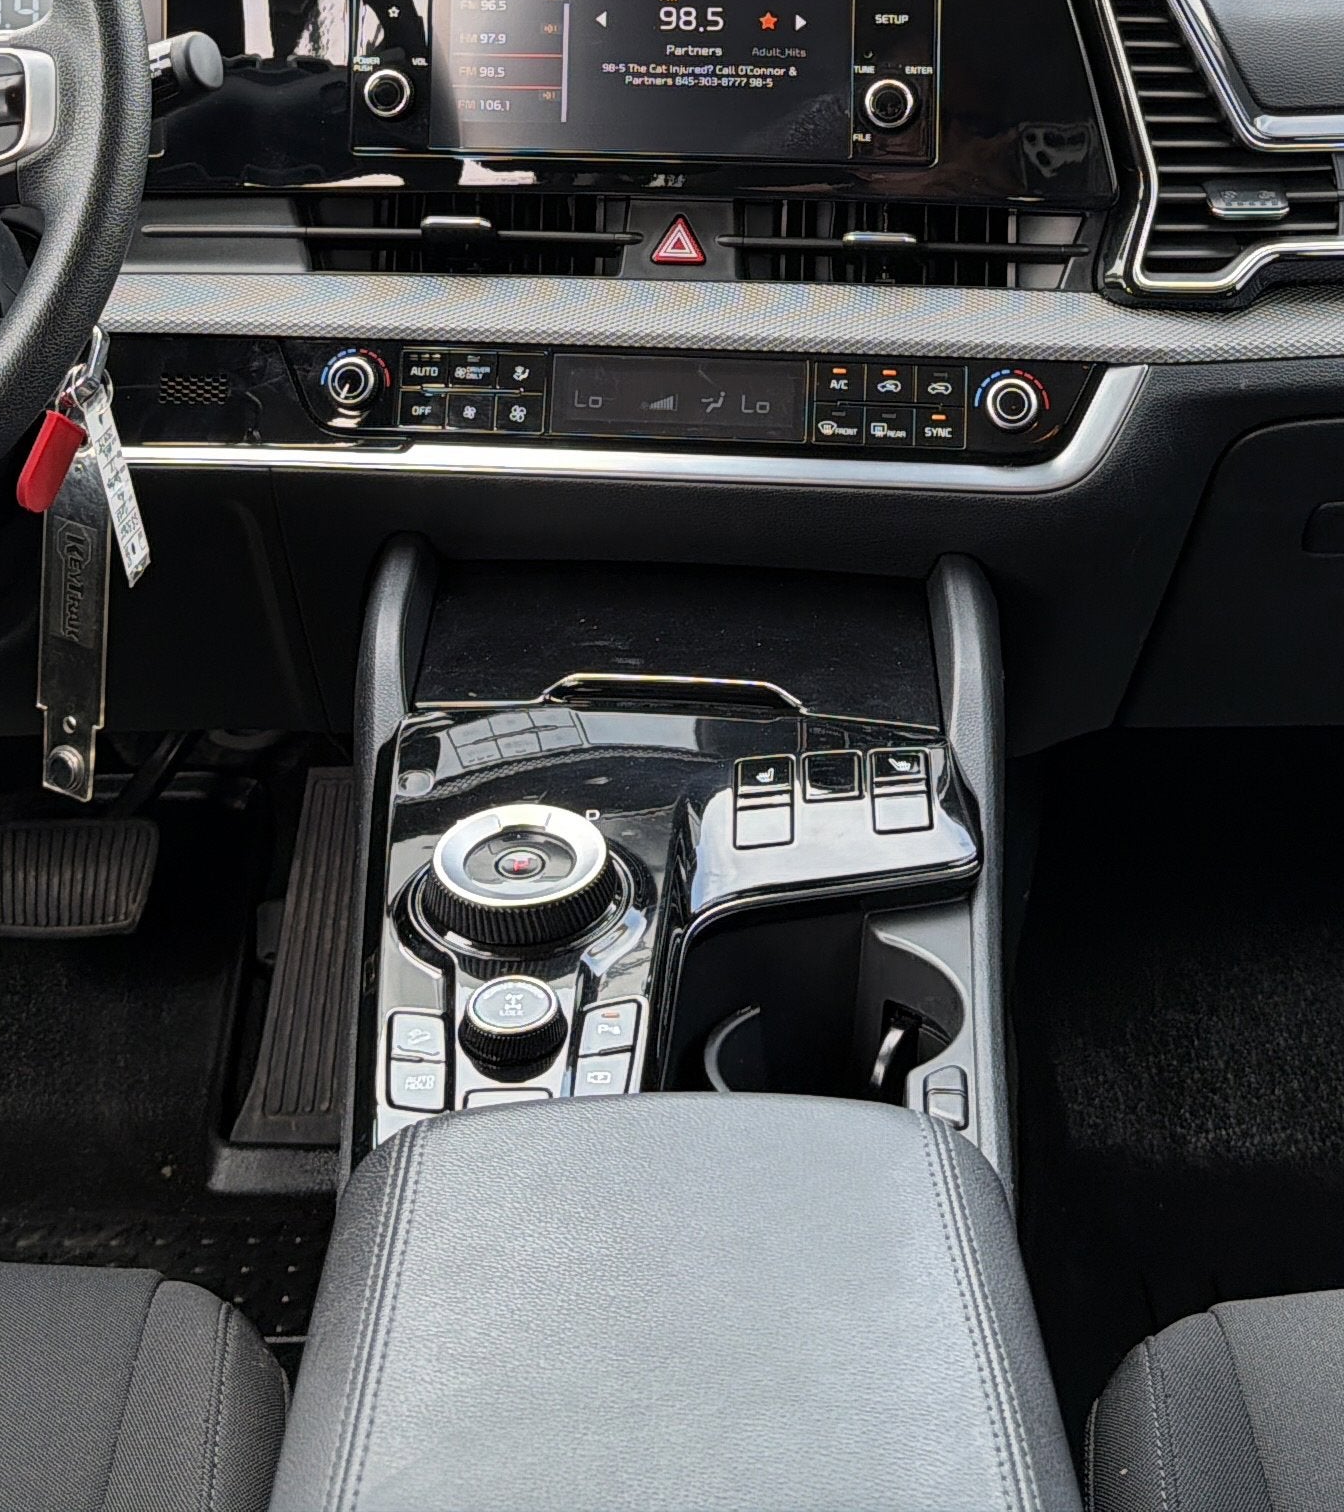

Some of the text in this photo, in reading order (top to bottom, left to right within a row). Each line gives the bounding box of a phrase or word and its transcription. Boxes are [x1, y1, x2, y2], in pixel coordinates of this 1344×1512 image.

[480, 0, 507, 11] 96.5
[659, 6, 725, 32] 98.5
[875, 14, 909, 25] SETUP
[480, 33, 507, 45] 97.9
[666, 45, 723, 57] Partners
[353, 56, 380, 65] POWER
[411, 57, 428, 66] VOL
[479, 66, 506, 78] 98.5
[628, 63, 647, 74] The
[649, 64, 668, 74] Cat
[669, 64, 714, 76] Injured?
[716, 65, 736, 75] Call
[788, 66, 798, 76] &
[854, 65, 875, 74] TUNE
[905, 65, 933, 74] ENTER
[625, 75, 673, 85] Partners
[458, 99, 511, 111] FM 106.1
[853, 133, 872, 142] FILE
[410, 366, 439, 377] AUTO
[830, 379, 848, 390] A/C
[411, 405, 432, 416] OFF
[835, 427, 858, 436] FRONT
[924, 426, 953, 438] SYNC
